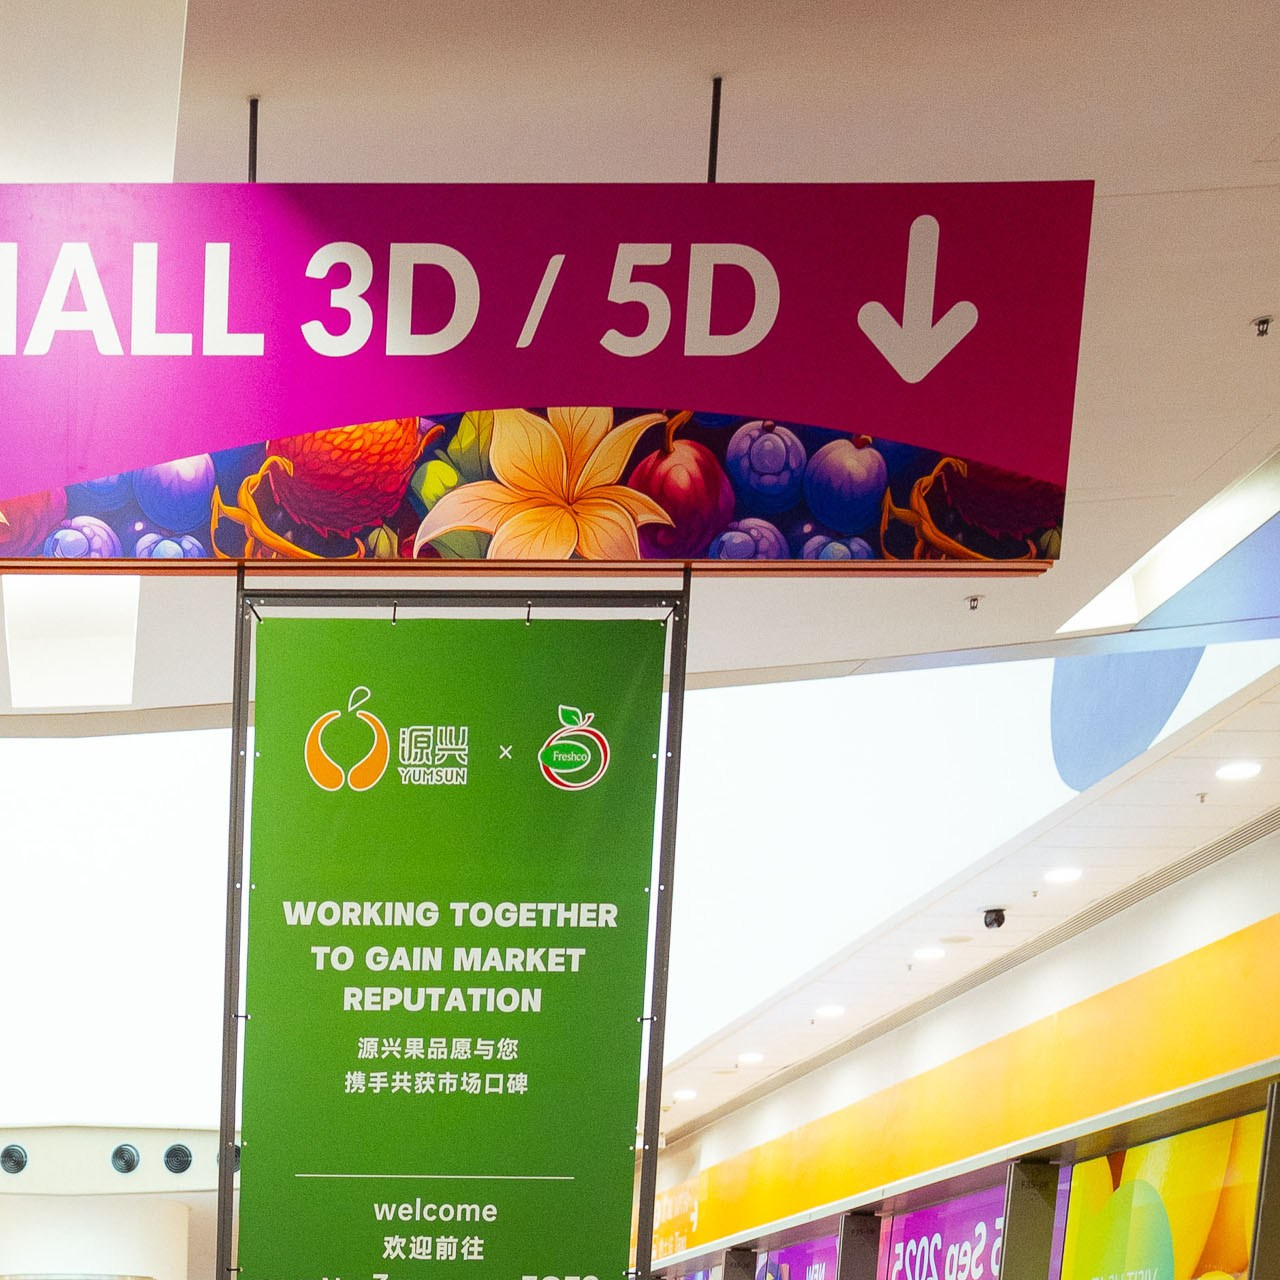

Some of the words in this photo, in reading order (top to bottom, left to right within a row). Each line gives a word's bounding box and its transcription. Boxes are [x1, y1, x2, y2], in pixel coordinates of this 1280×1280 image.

[301, 241, 480, 357] 3D
[515, 253, 566, 349] /
[599, 242, 781, 357] 5D
[553, 751, 588, 762] Freshco
[398, 767, 467, 785] YUMSUN
[282, 901, 440, 927] WORKING
[450, 902, 618, 928] TOGETHER
[311, 946, 354, 971] TO
[365, 946, 442, 972] GAIN
[453, 947, 586, 973] MARKET
[343, 987, 542, 1013] REPUTATION
[357, 1037, 519, 1061] 源兴果品愿与您
[344, 1071, 529, 1095] 携手共获市场口碑
[373, 1198, 498, 1222] welcome
[382, 1235, 484, 1261] 欢迎前往
